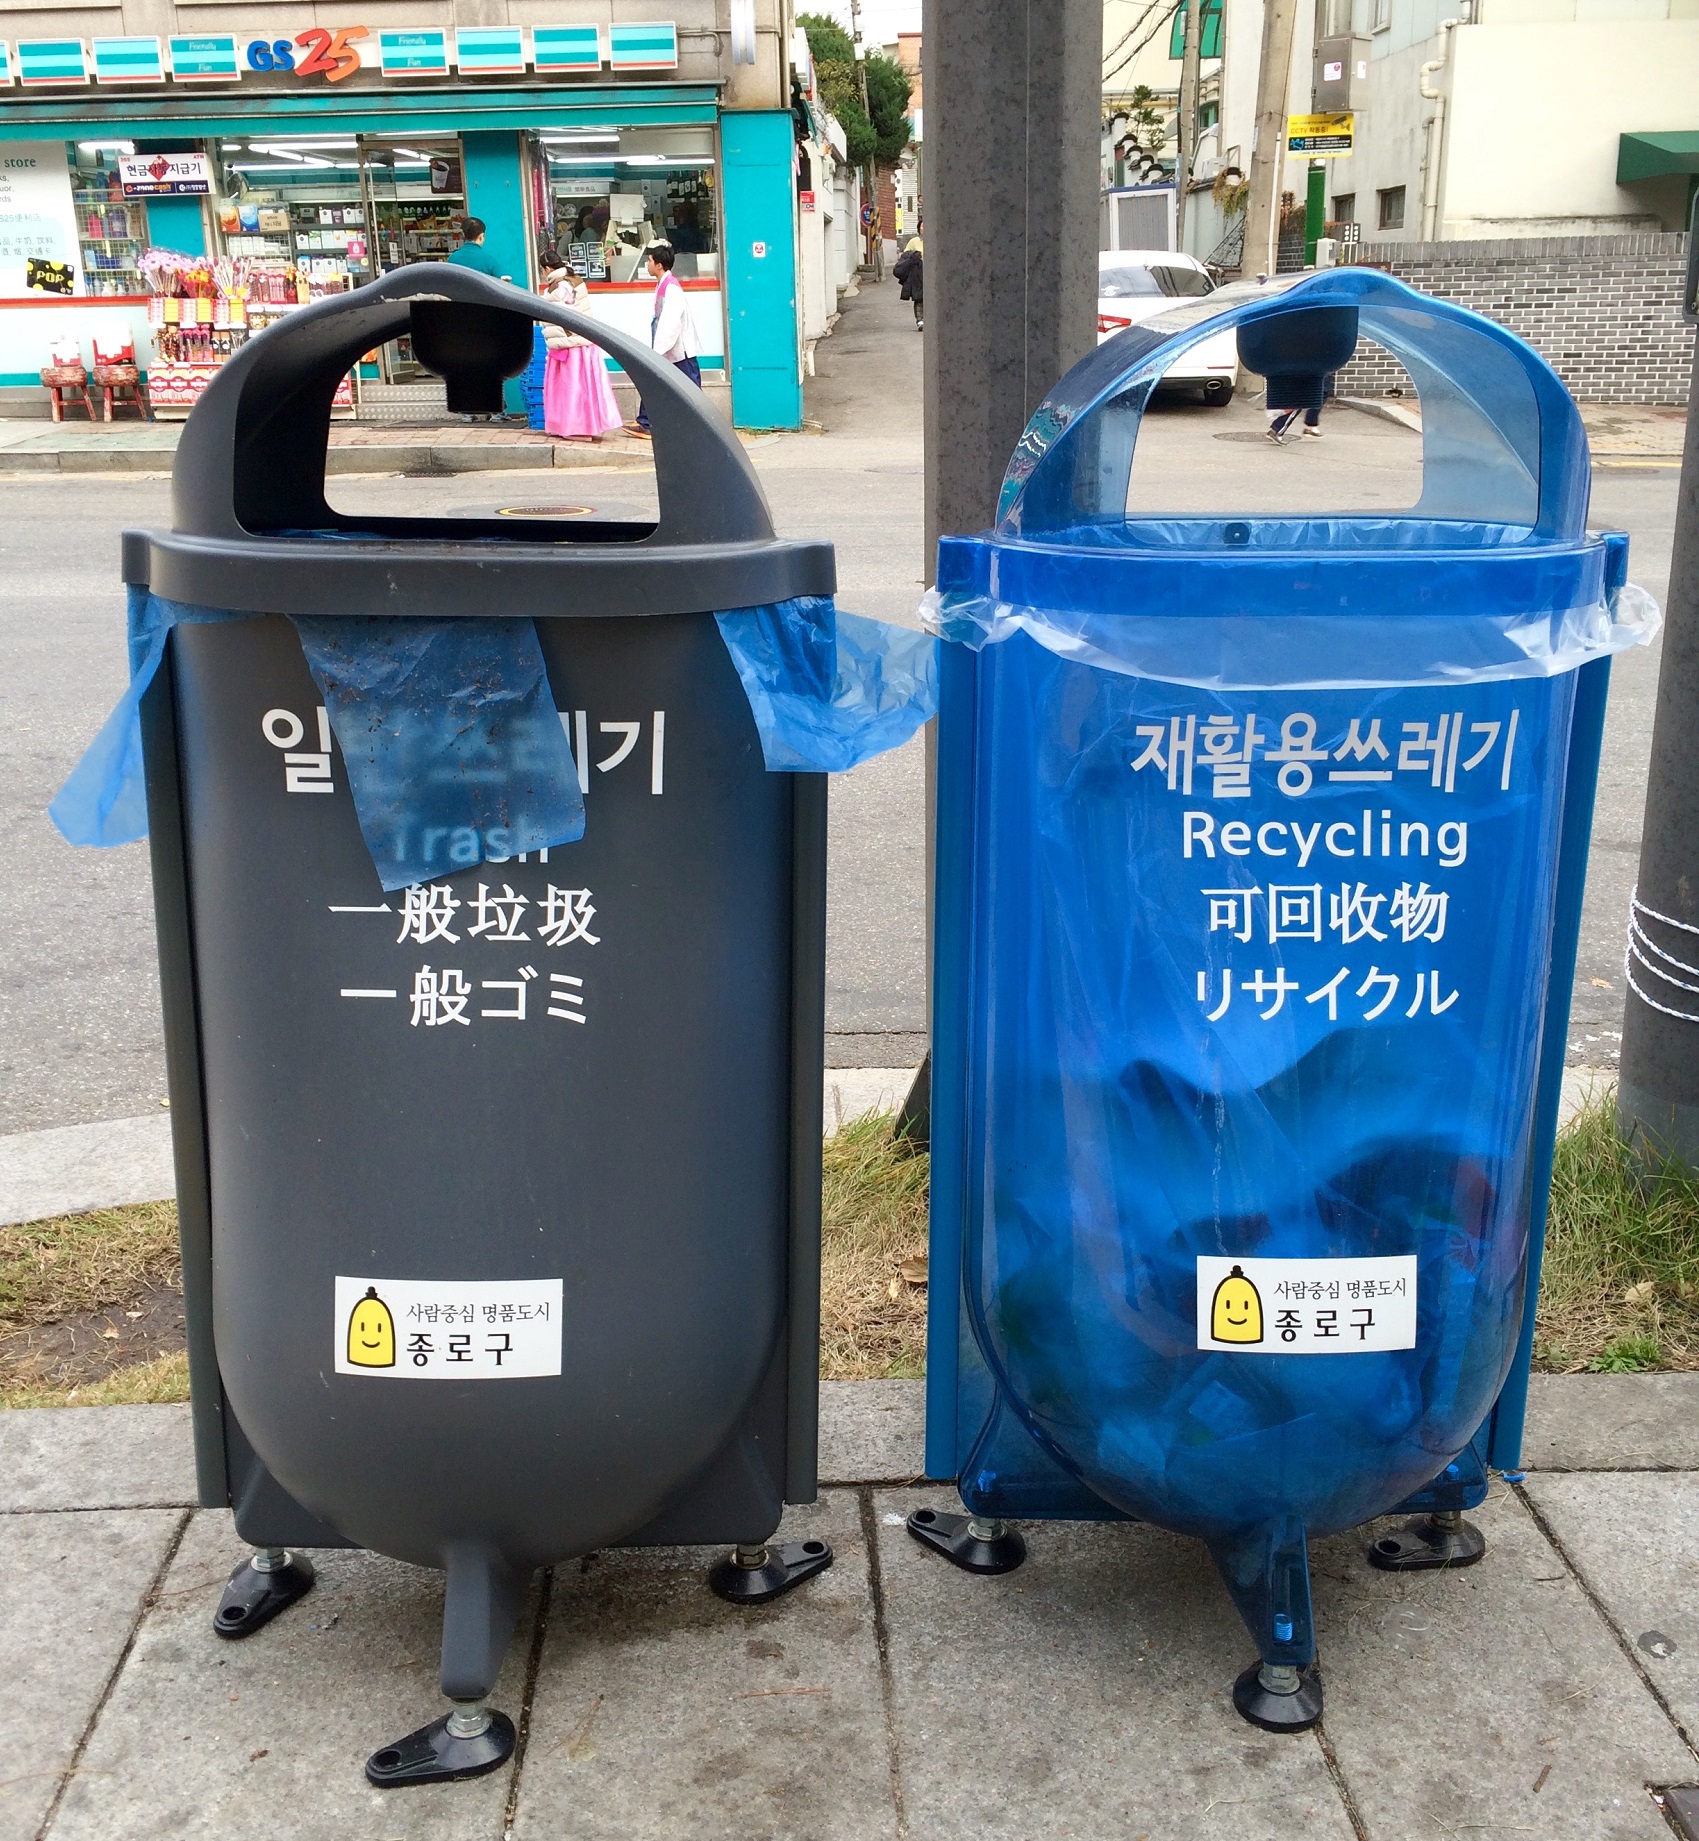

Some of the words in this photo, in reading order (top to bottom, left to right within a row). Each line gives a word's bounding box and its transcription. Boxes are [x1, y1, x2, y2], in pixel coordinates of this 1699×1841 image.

[247, 24, 370, 83] GS25
[4, 158, 37, 168] store
[36, 270, 65, 284] POP
[1130, 708, 1521, 799] 재활용쓰레기
[1182, 809, 1468, 868] Recycling
[327, 882, 602, 947] 一般垃圾
[1200, 882, 1450, 945] 可回收物
[340, 964, 588, 1028] 一般ゴミ
[1197, 965, 1460, 1022] リサイクル
[406, 1303, 475, 1324] 사람중심
[481, 1301, 551, 1323] 명품도시
[1273, 1280, 1341, 1300] 사람중심
[1346, 1277, 1407, 1299] 명품도시
